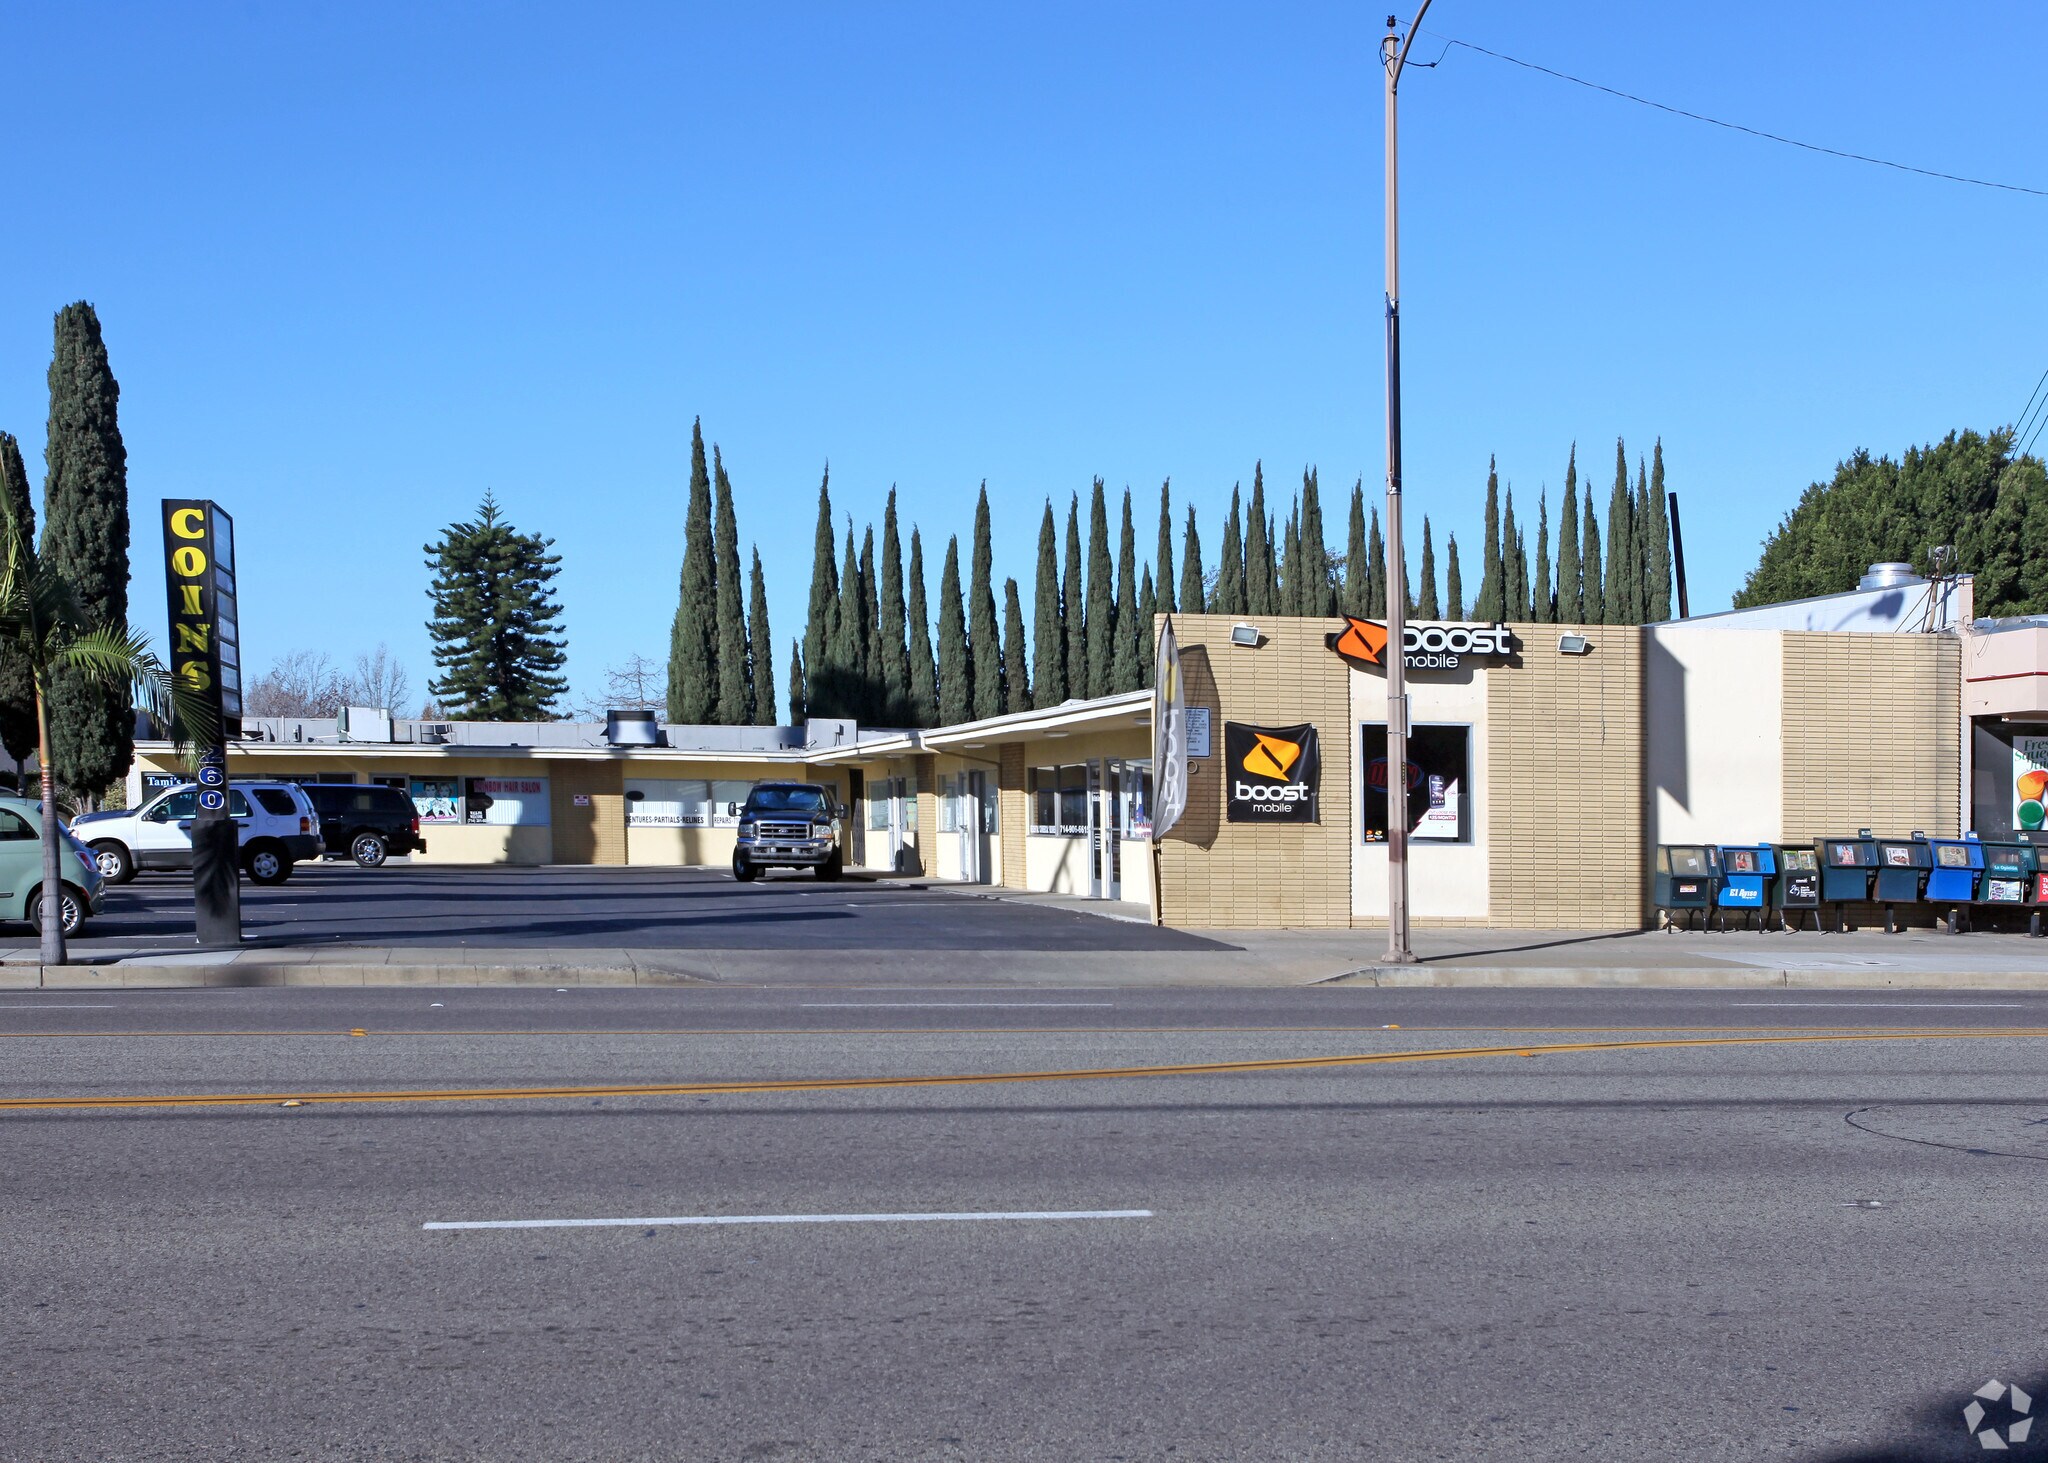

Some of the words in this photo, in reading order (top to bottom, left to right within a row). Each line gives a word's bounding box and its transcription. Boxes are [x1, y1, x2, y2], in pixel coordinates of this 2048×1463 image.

[170, 508, 211, 692] COINS
[146, 776, 182, 787] Tami's
[198, 745, 225, 810] 260
[504, 781, 519, 793] HAIR
[521, 781, 541, 793] SALON
[1235, 781, 1309, 801] boost
[1252, 803, 1292, 813] mobile
[1729, 888, 1739, 897] El
